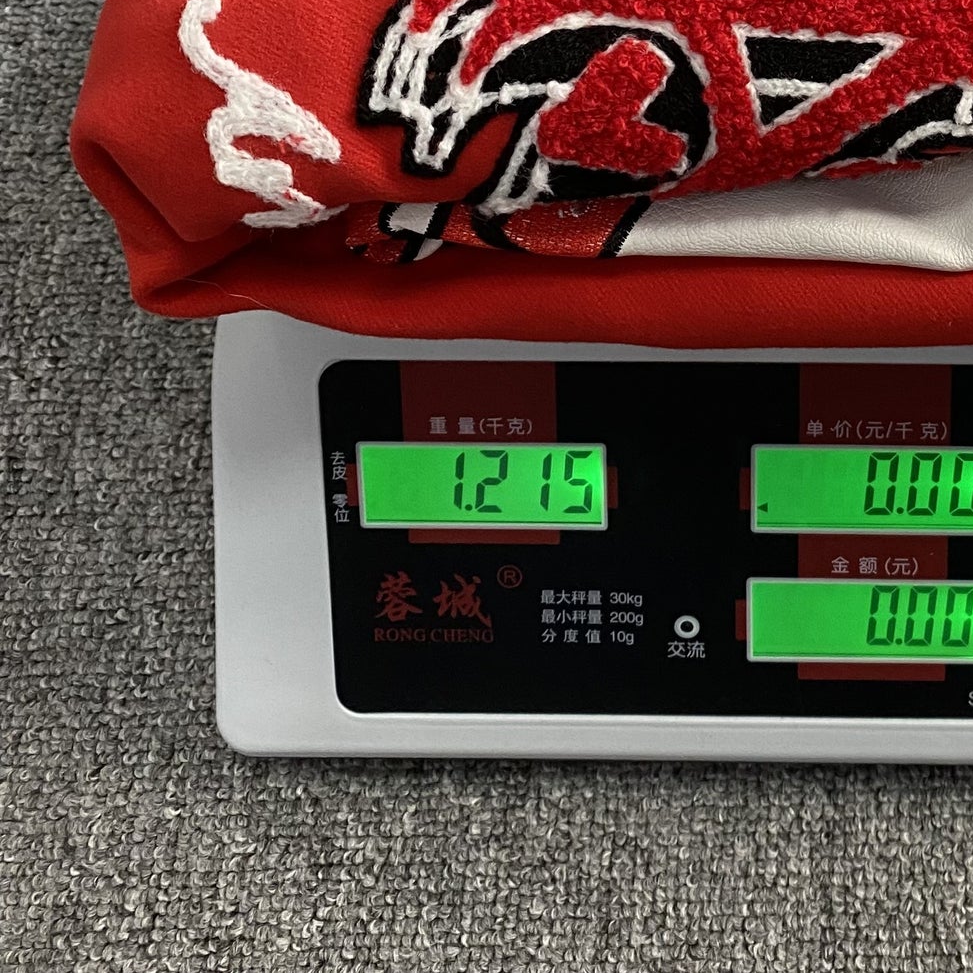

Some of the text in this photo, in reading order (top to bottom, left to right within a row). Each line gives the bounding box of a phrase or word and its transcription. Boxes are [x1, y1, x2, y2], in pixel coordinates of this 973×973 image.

[429, 416, 533, 436] 重量(千克)
[330, 451, 350, 523] 去皮 零位
[453, 450, 593, 514] 1.215
[831, 556, 919, 576] 金额(元)
[374, 570, 493, 627] 蓉城
[540, 590, 643, 607] 最大秤量 30kg
[541, 609, 644, 626] 最小秤量 200g
[373, 628, 494, 643] RONG CHENG
[541, 629, 634, 645] 分度值 10g
[667, 640, 706, 659] 交流
